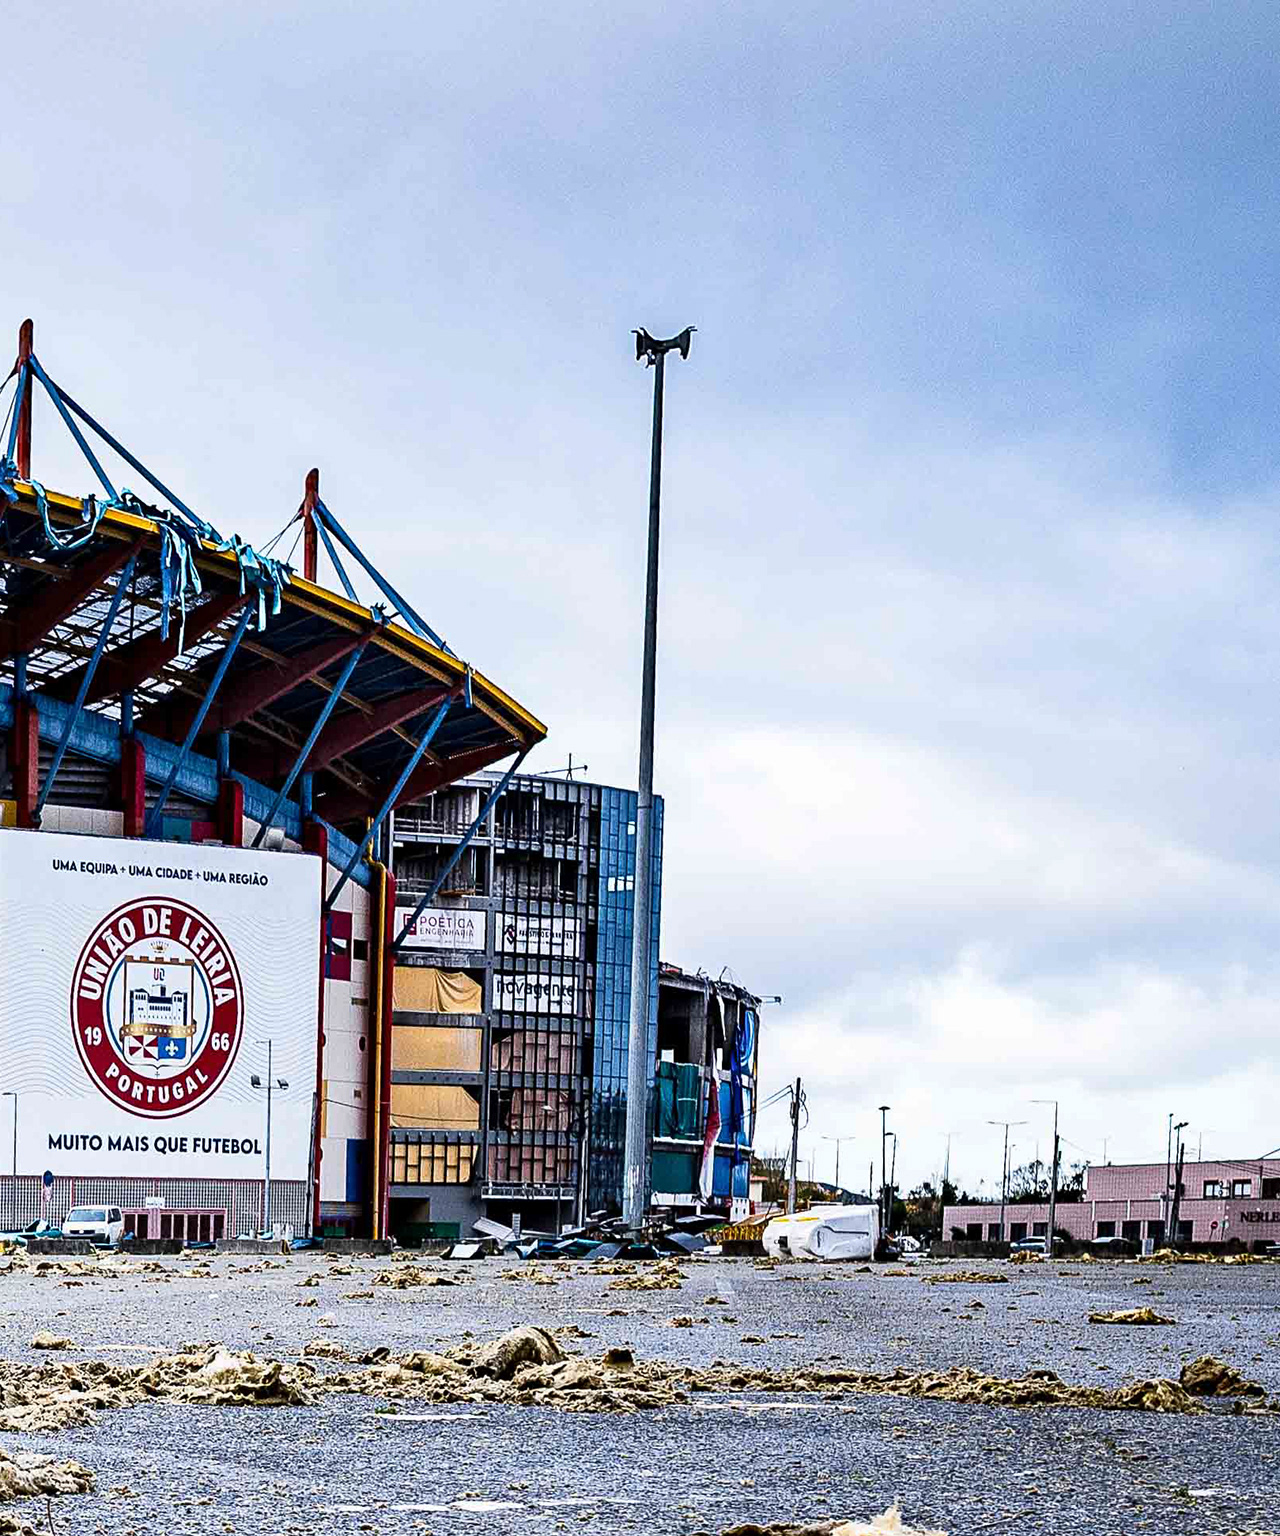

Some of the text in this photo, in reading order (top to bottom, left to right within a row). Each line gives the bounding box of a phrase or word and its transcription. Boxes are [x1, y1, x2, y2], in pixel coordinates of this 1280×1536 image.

[52, 859, 77, 872] UMA
[80, 861, 118, 875] EQUIPA
[128, 865, 153, 878] UMA
[155, 867, 193, 880] CIDADE
[203, 871, 227, 883] UMA
[228, 872, 269, 886] REGIÃO
[79, 907, 235, 1007] UNIÃO DE LEIRIA
[84, 1026, 230, 1051] 19 66
[105, 1062, 209, 1104] PORTUGAL
[48, 1133, 262, 1155] MUITO MAIS QUE FUTEBOL
